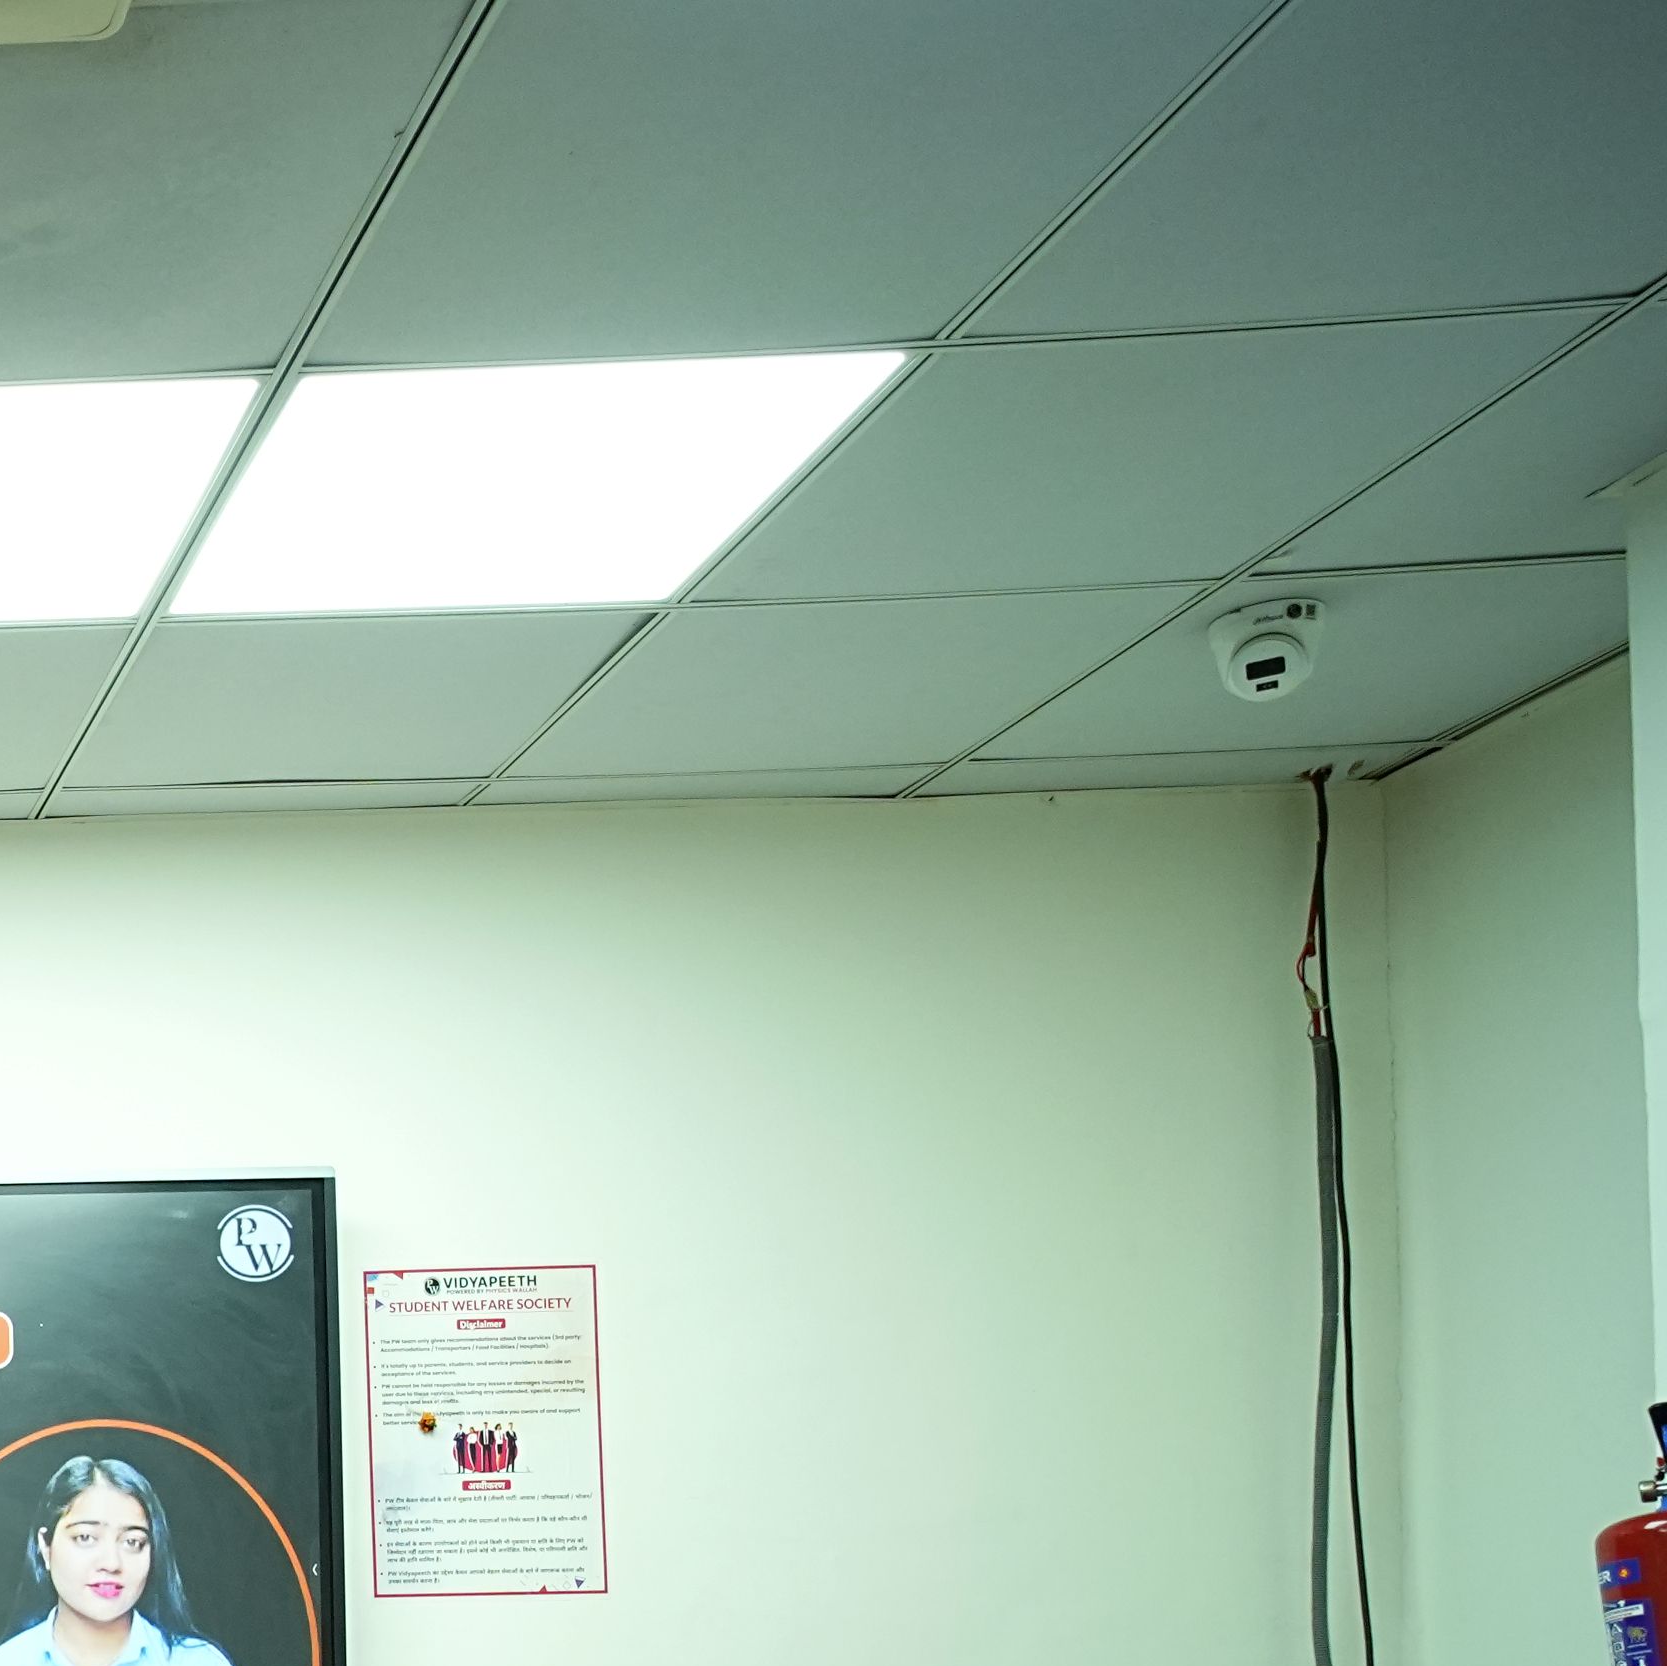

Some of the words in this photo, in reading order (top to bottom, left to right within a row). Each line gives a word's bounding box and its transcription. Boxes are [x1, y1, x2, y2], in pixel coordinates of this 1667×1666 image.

[443, 1275, 538, 1290] VIDYAPEETH
[389, 1301, 450, 1313] STUDENT
[453, 1299, 514, 1312] WELFARE
[517, 1298, 572, 1311] SOCIETY
[459, 1319, 503, 1330] Disclaimer
